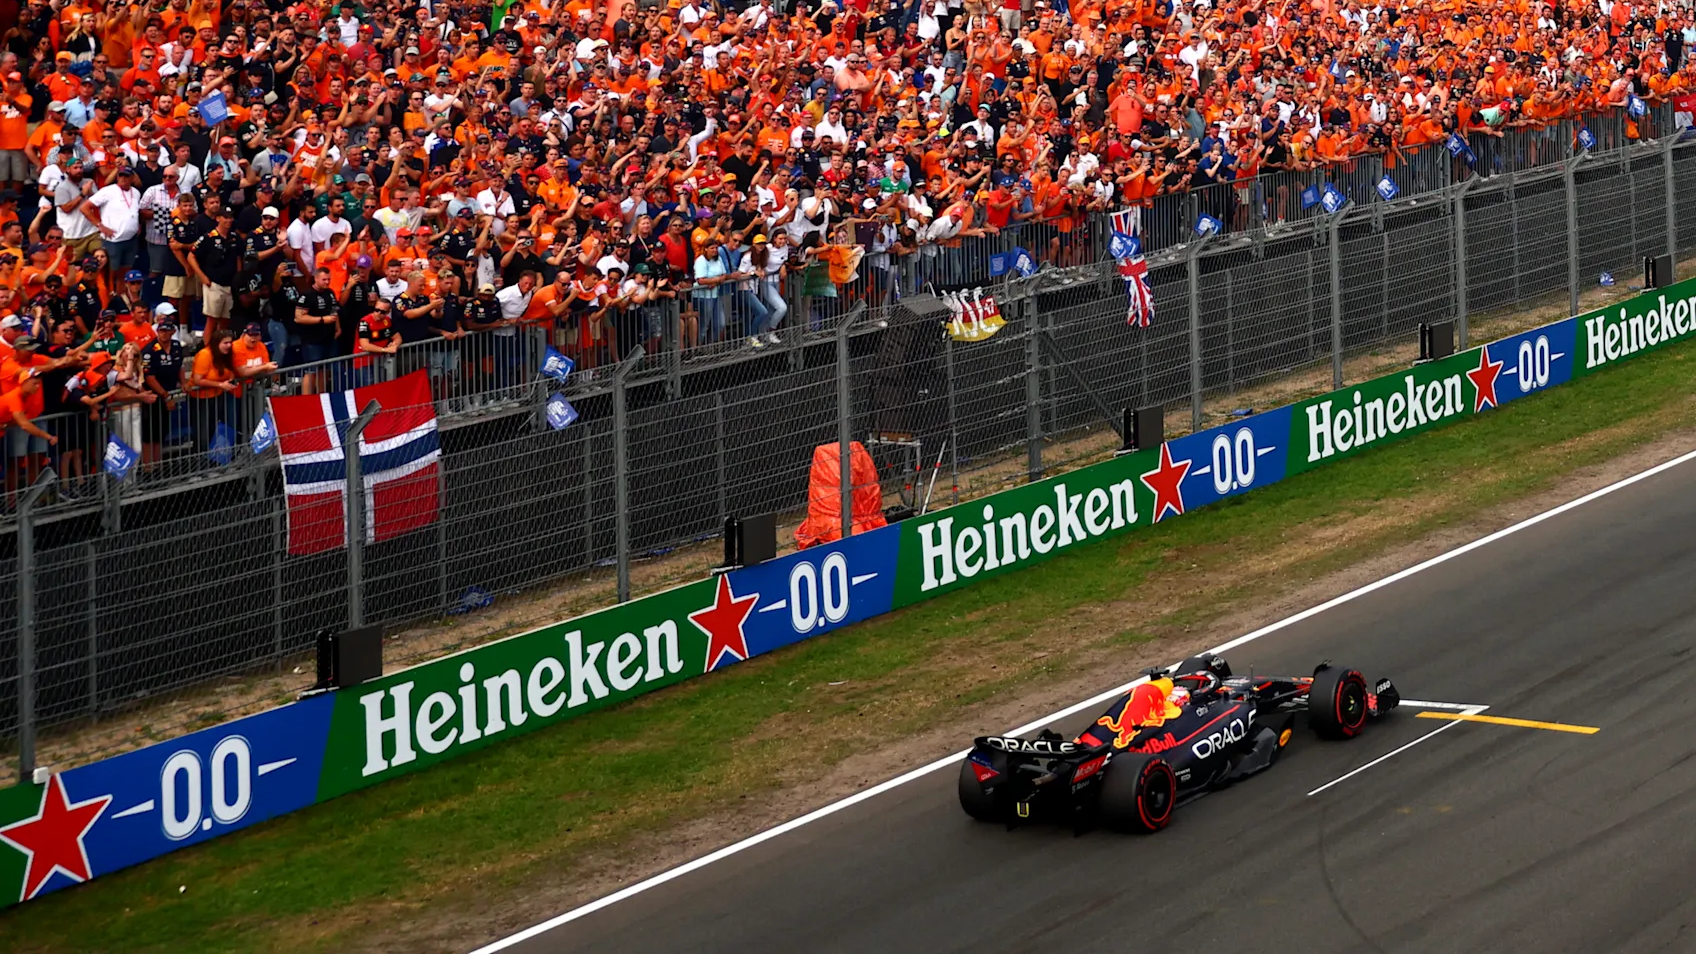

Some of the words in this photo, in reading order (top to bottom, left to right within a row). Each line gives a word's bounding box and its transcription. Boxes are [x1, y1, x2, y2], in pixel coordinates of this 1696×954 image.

[1306, 374, 1464, 462] Heineken
[1518, 335, 1551, 392] 0.0
[917, 482, 1139, 592] Heineken
[1212, 427, 1257, 494] 0.0
[360, 619, 684, 776] Heineken
[790, 551, 850, 634] 0.0
[987, 737, 1078, 754] ORACLE
[1150, 732, 1178, 753] Bull
[1192, 709, 1257, 759] ORACLE
[161, 735, 252, 842] 0.0
